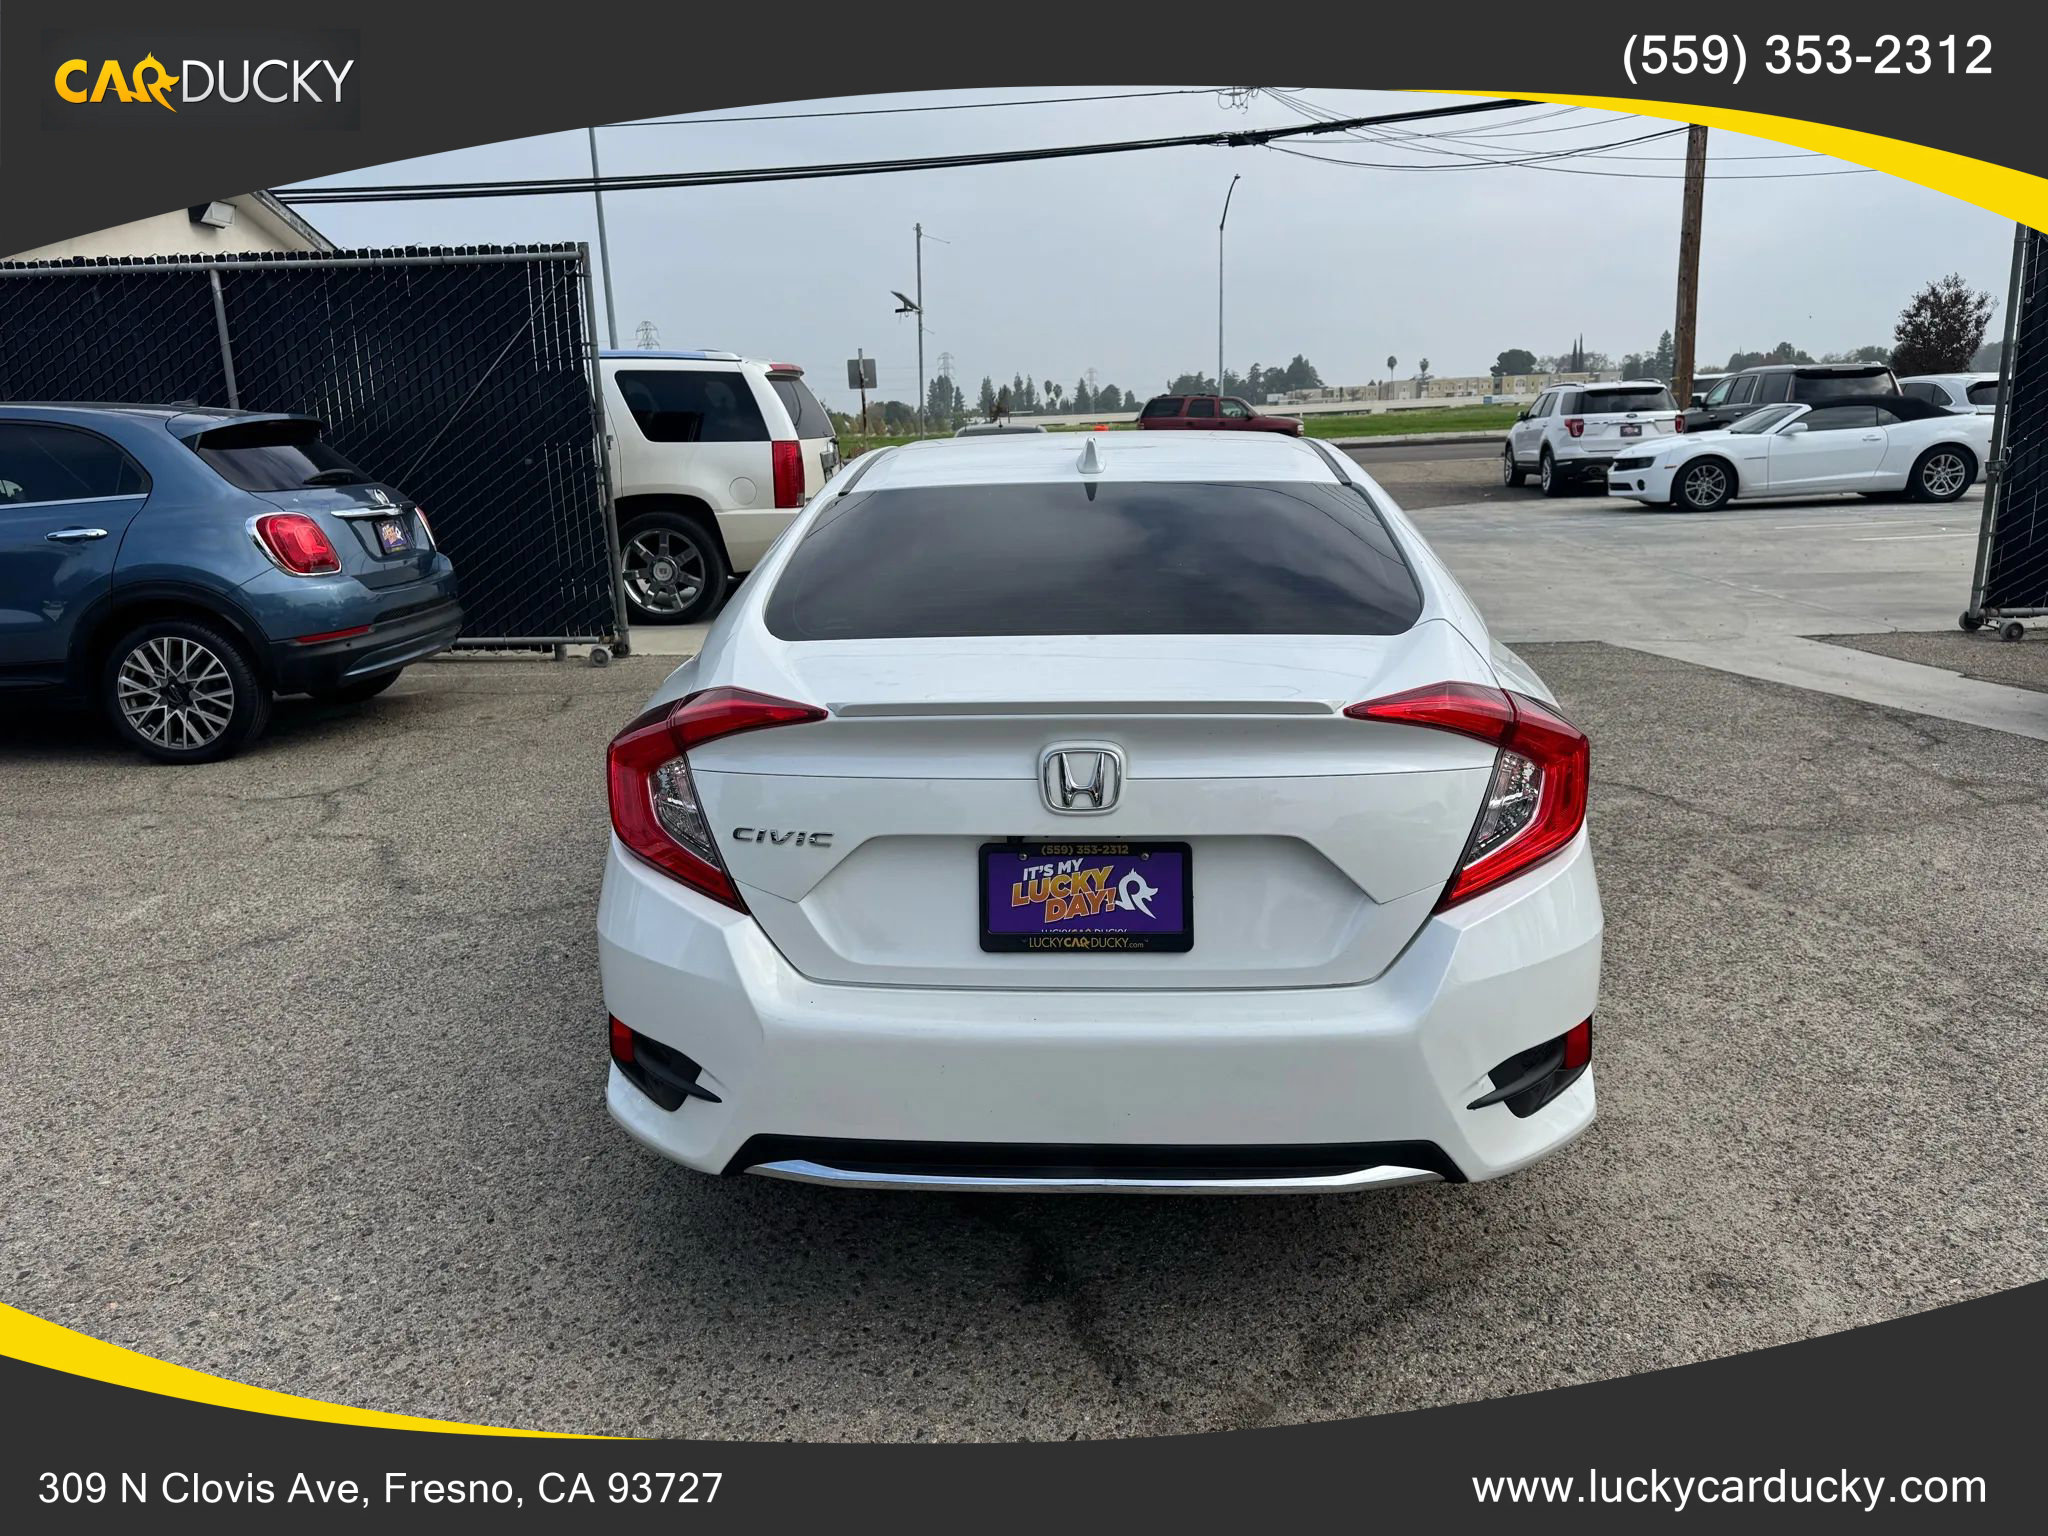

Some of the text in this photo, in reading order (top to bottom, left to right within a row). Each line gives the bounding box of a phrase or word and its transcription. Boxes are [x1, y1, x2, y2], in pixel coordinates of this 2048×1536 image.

[732, 827, 835, 848] CIVIC
[1041, 844, 1129, 856] (559) 353-2312
[1022, 857, 1084, 881] IT'S MY
[1011, 865, 1114, 907] LUCKY
[1044, 887, 1117, 923] DAY!
